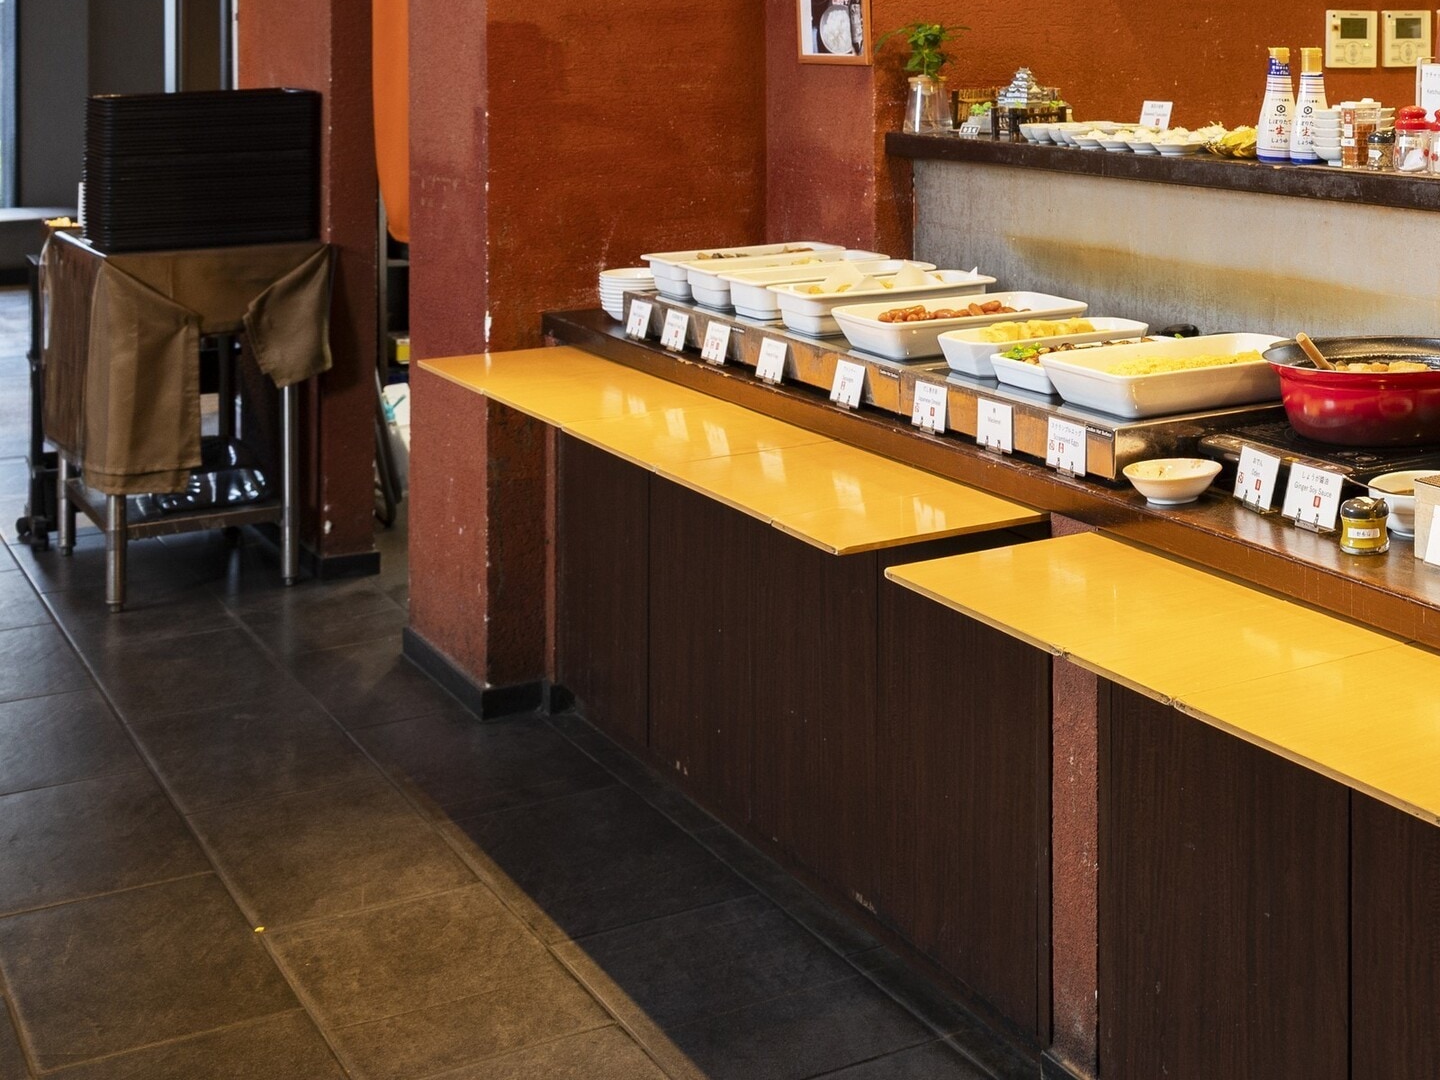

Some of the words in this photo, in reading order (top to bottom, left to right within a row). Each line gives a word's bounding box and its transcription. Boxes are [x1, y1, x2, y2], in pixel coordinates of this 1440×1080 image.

[1275, 125, 1285, 135] 生
[1302, 126, 1310, 137] 生
[1294, 480, 1309, 492] Ginger
[1309, 485, 1319, 494] Soy
[1319, 488, 1332, 499] Sauce
